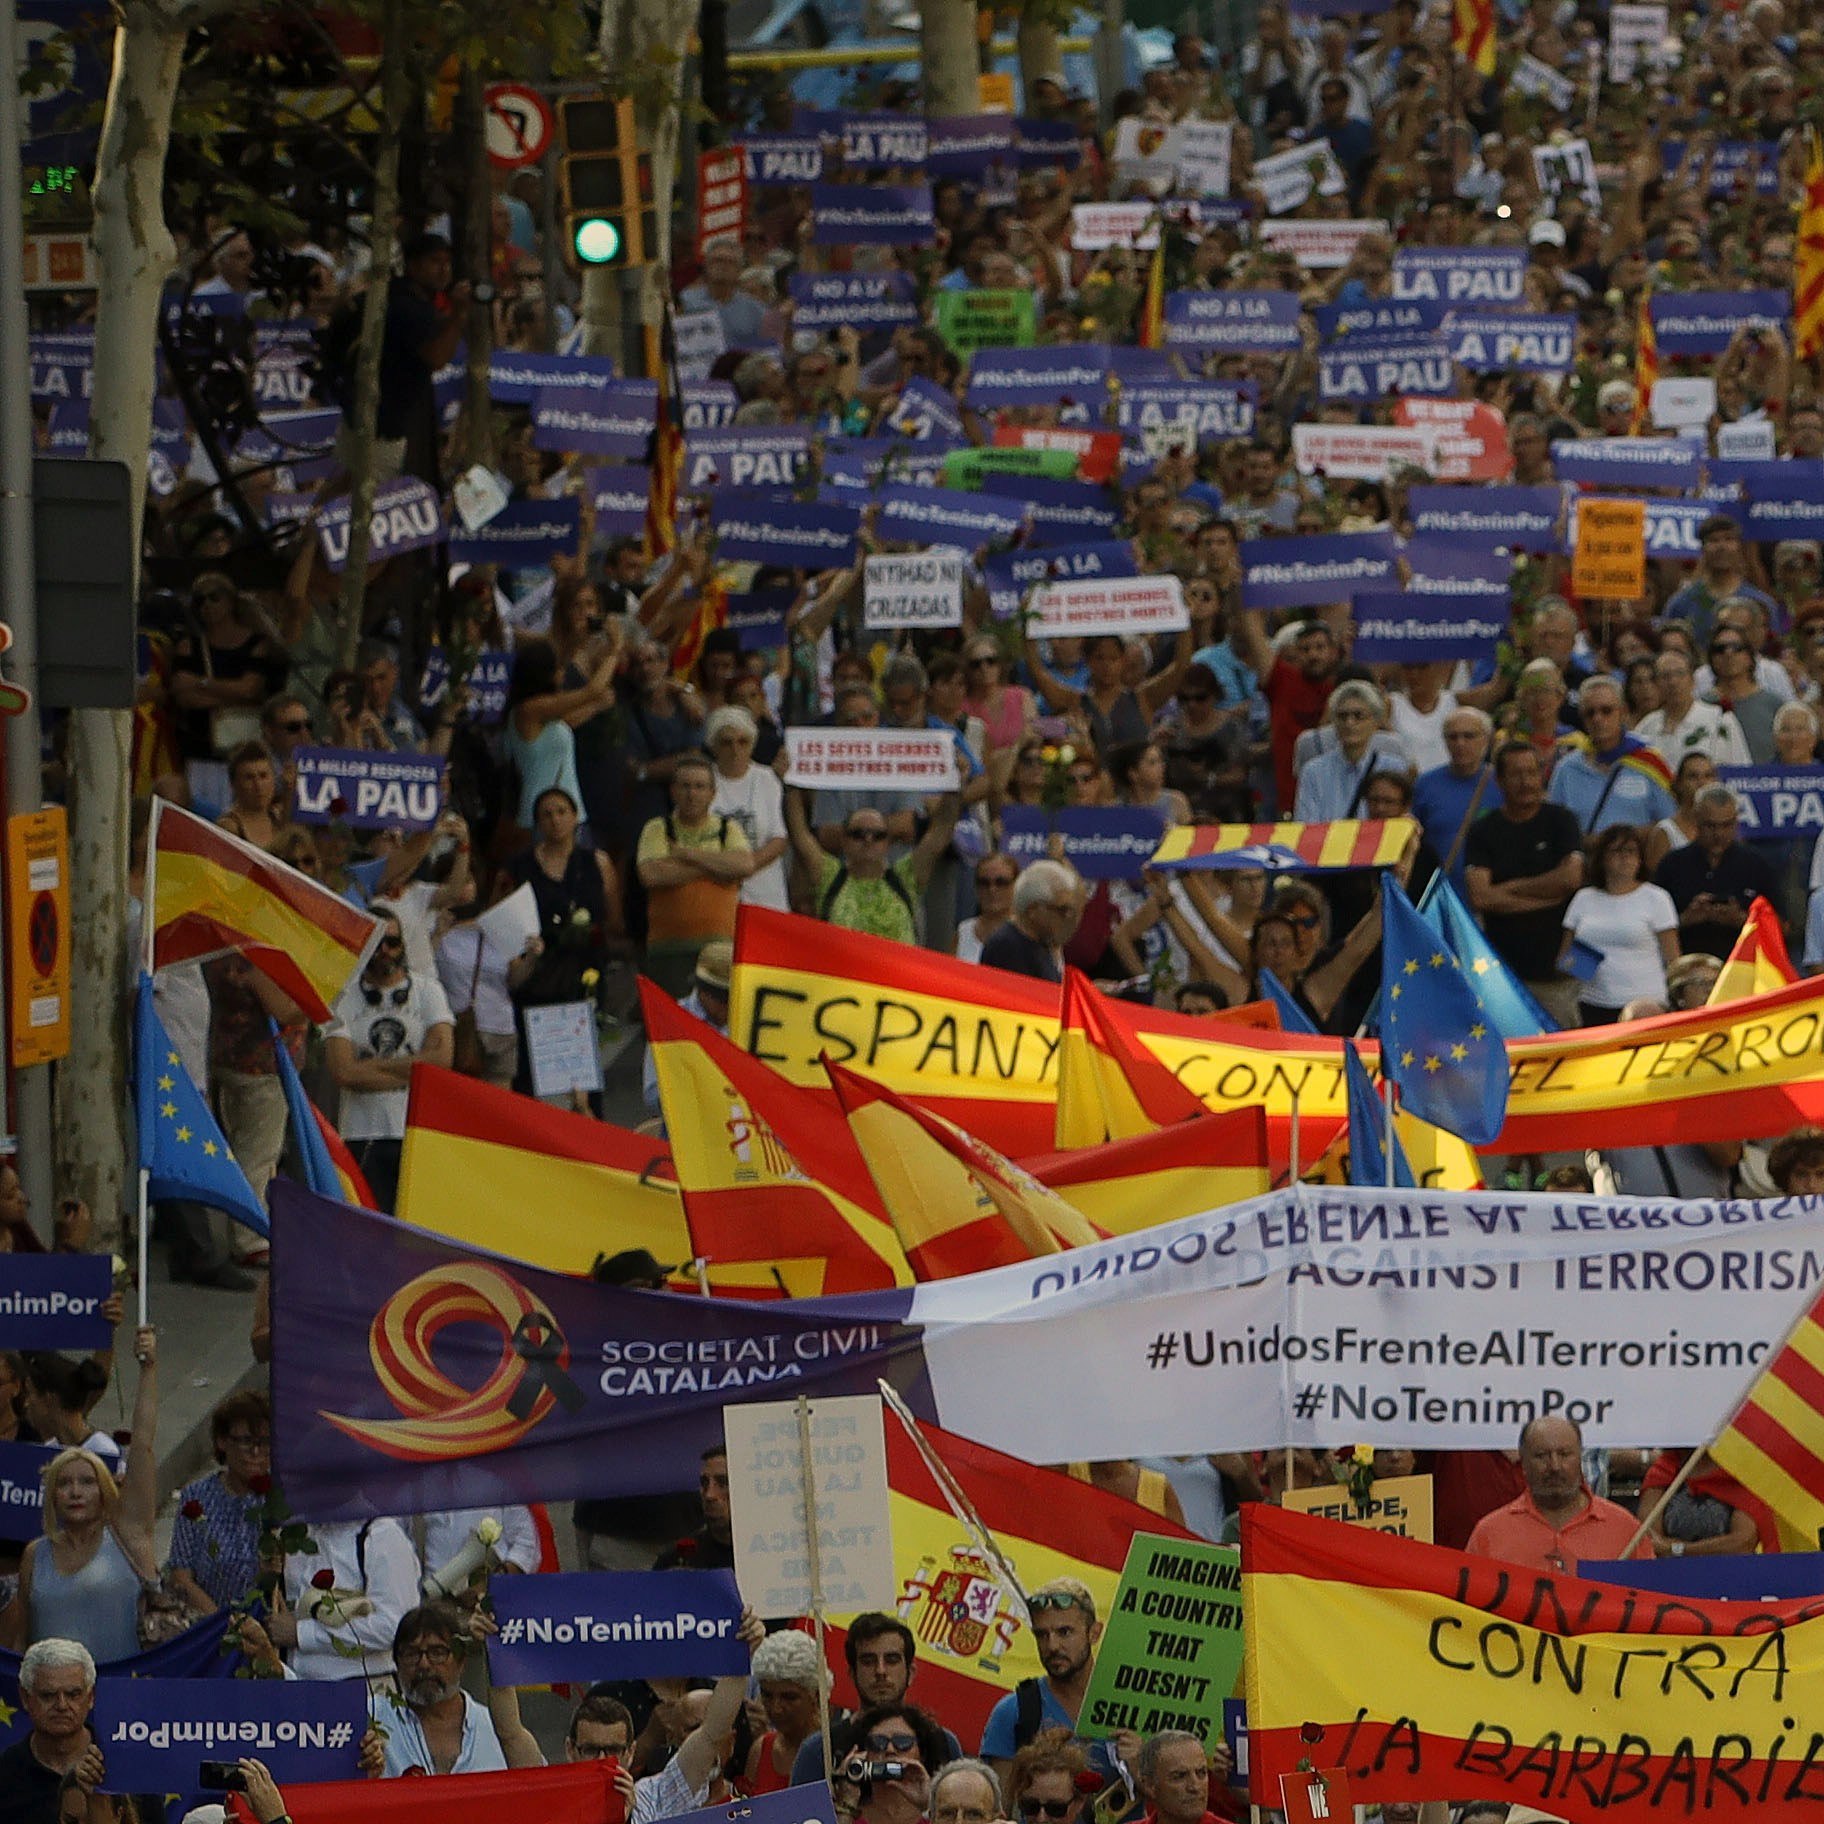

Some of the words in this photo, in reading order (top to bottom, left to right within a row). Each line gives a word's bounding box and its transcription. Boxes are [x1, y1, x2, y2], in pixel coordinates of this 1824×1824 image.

[1395, 271, 1439, 299] LA
[1447, 270, 1522, 300] PAU
[1320, 362, 1370, 396] LA
[1378, 357, 1452, 392] PAU
[298, 775, 340, 812] LA
[357, 780, 437, 821] PAU
[748, 978, 1062, 1089] ESPANY
[1177, 1051, 1365, 1112] CONT
[1288, 1247, 1529, 1289] AGAINST
[600, 1336, 780, 1367] SOCIETAT
[794, 1326, 884, 1361] CIVIL
[599, 1362, 802, 1398] CATALANA
[1292, 1384, 1615, 1428] #NoTenimPor
[1428, 1614, 1791, 1704] CONTRA
